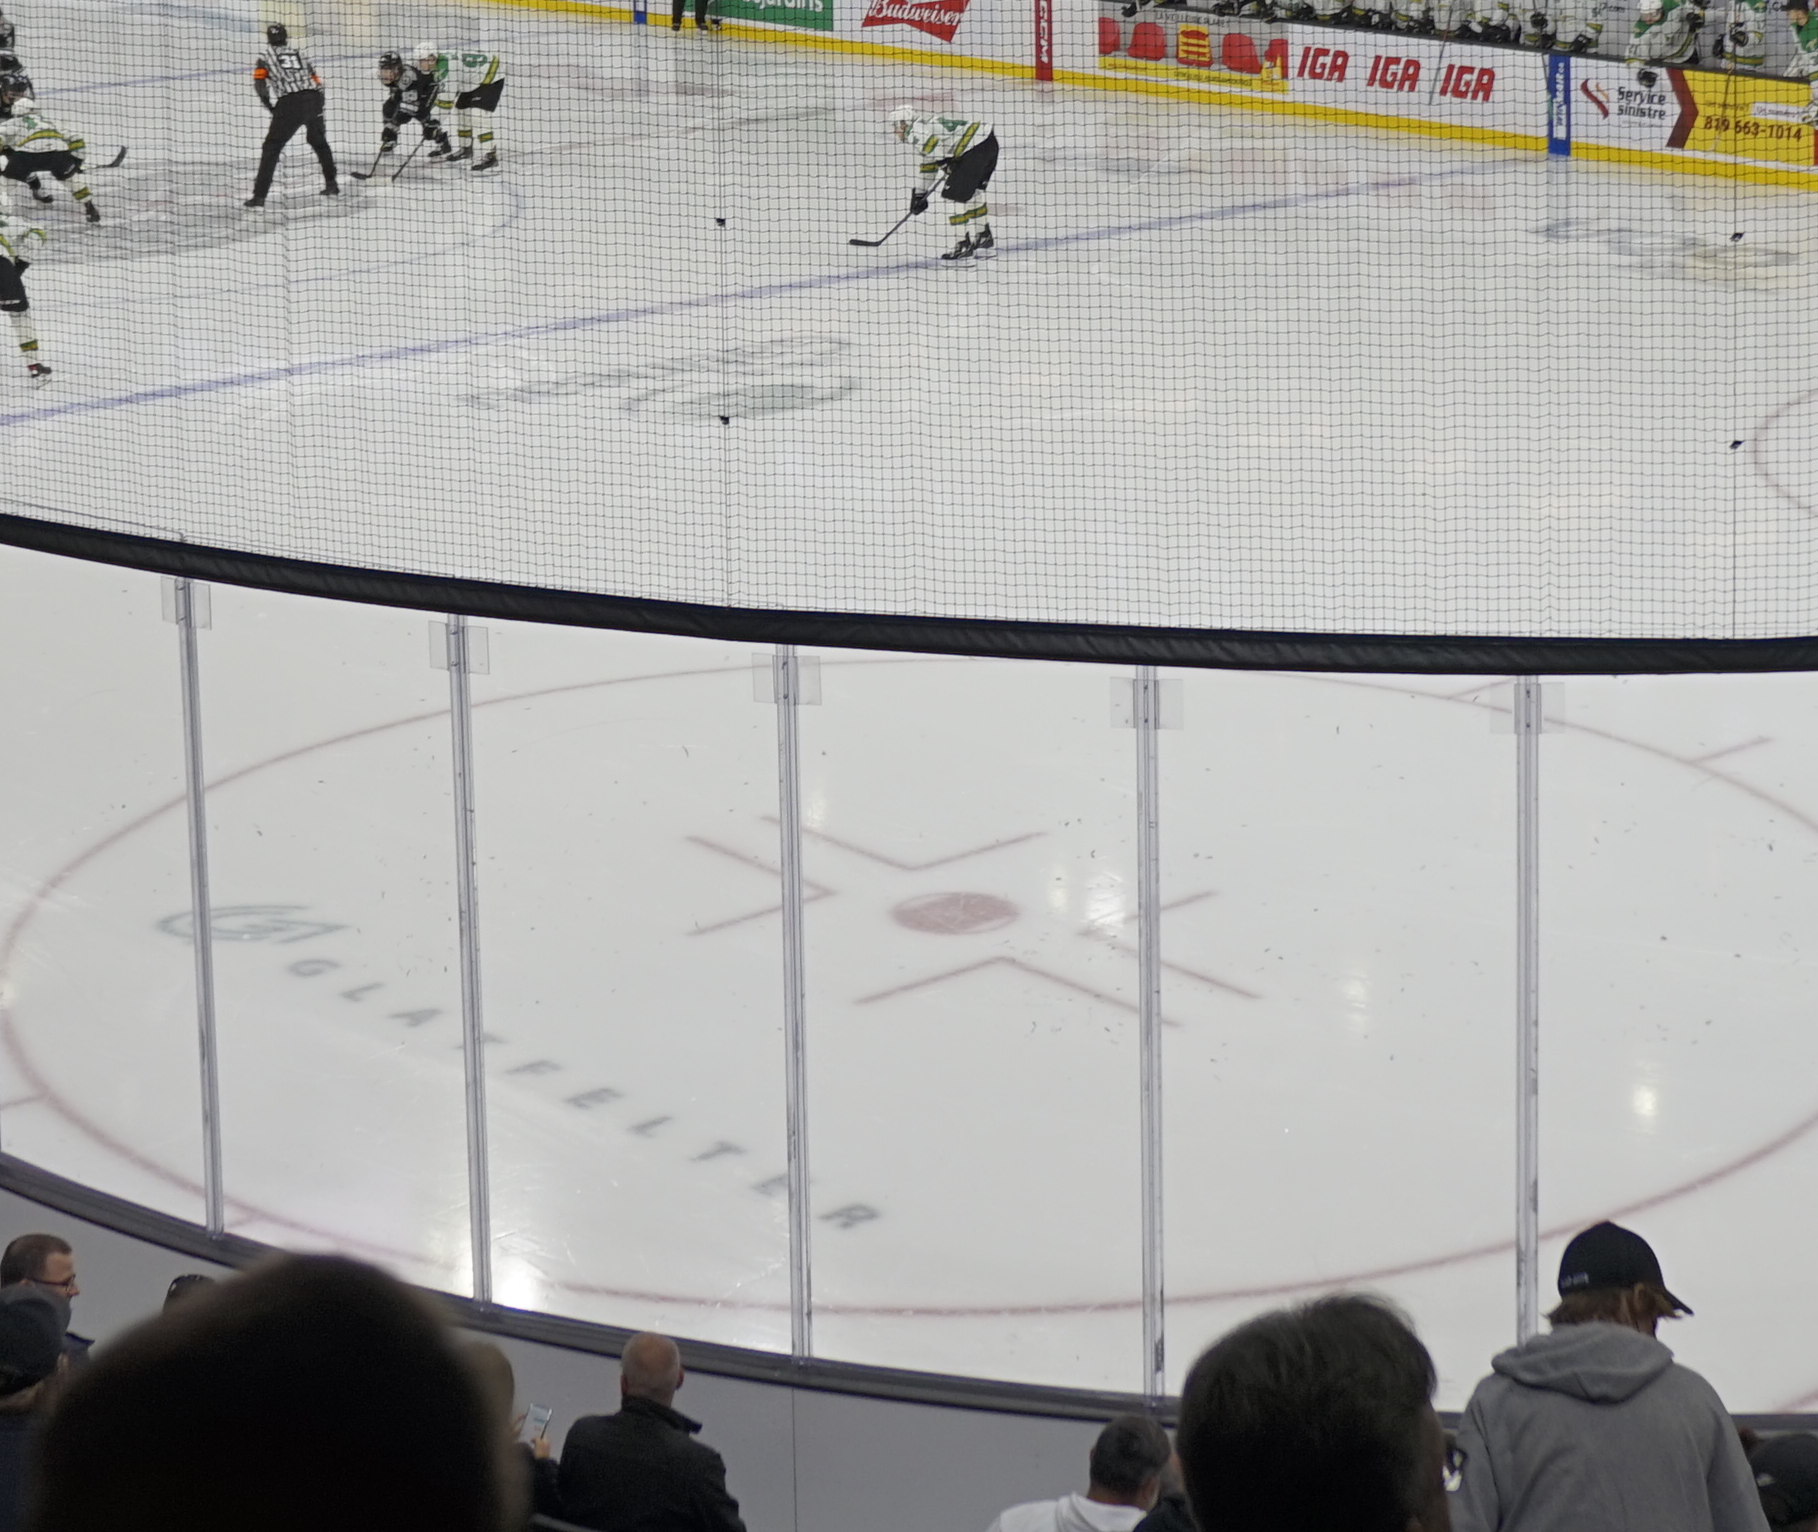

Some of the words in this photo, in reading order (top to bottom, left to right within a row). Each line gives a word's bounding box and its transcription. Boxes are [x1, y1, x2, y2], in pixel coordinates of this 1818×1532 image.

[1297, 45, 1350, 83] IGA
[1366, 54, 1421, 92] IGA
[1439, 63, 1496, 102] IGA
[1617, 86, 1667, 106] Service
[1617, 104, 1667, 121] sinistre
[1703, 115, 1730, 131] 819
[1734, 118, 1803, 142] 663-1014
